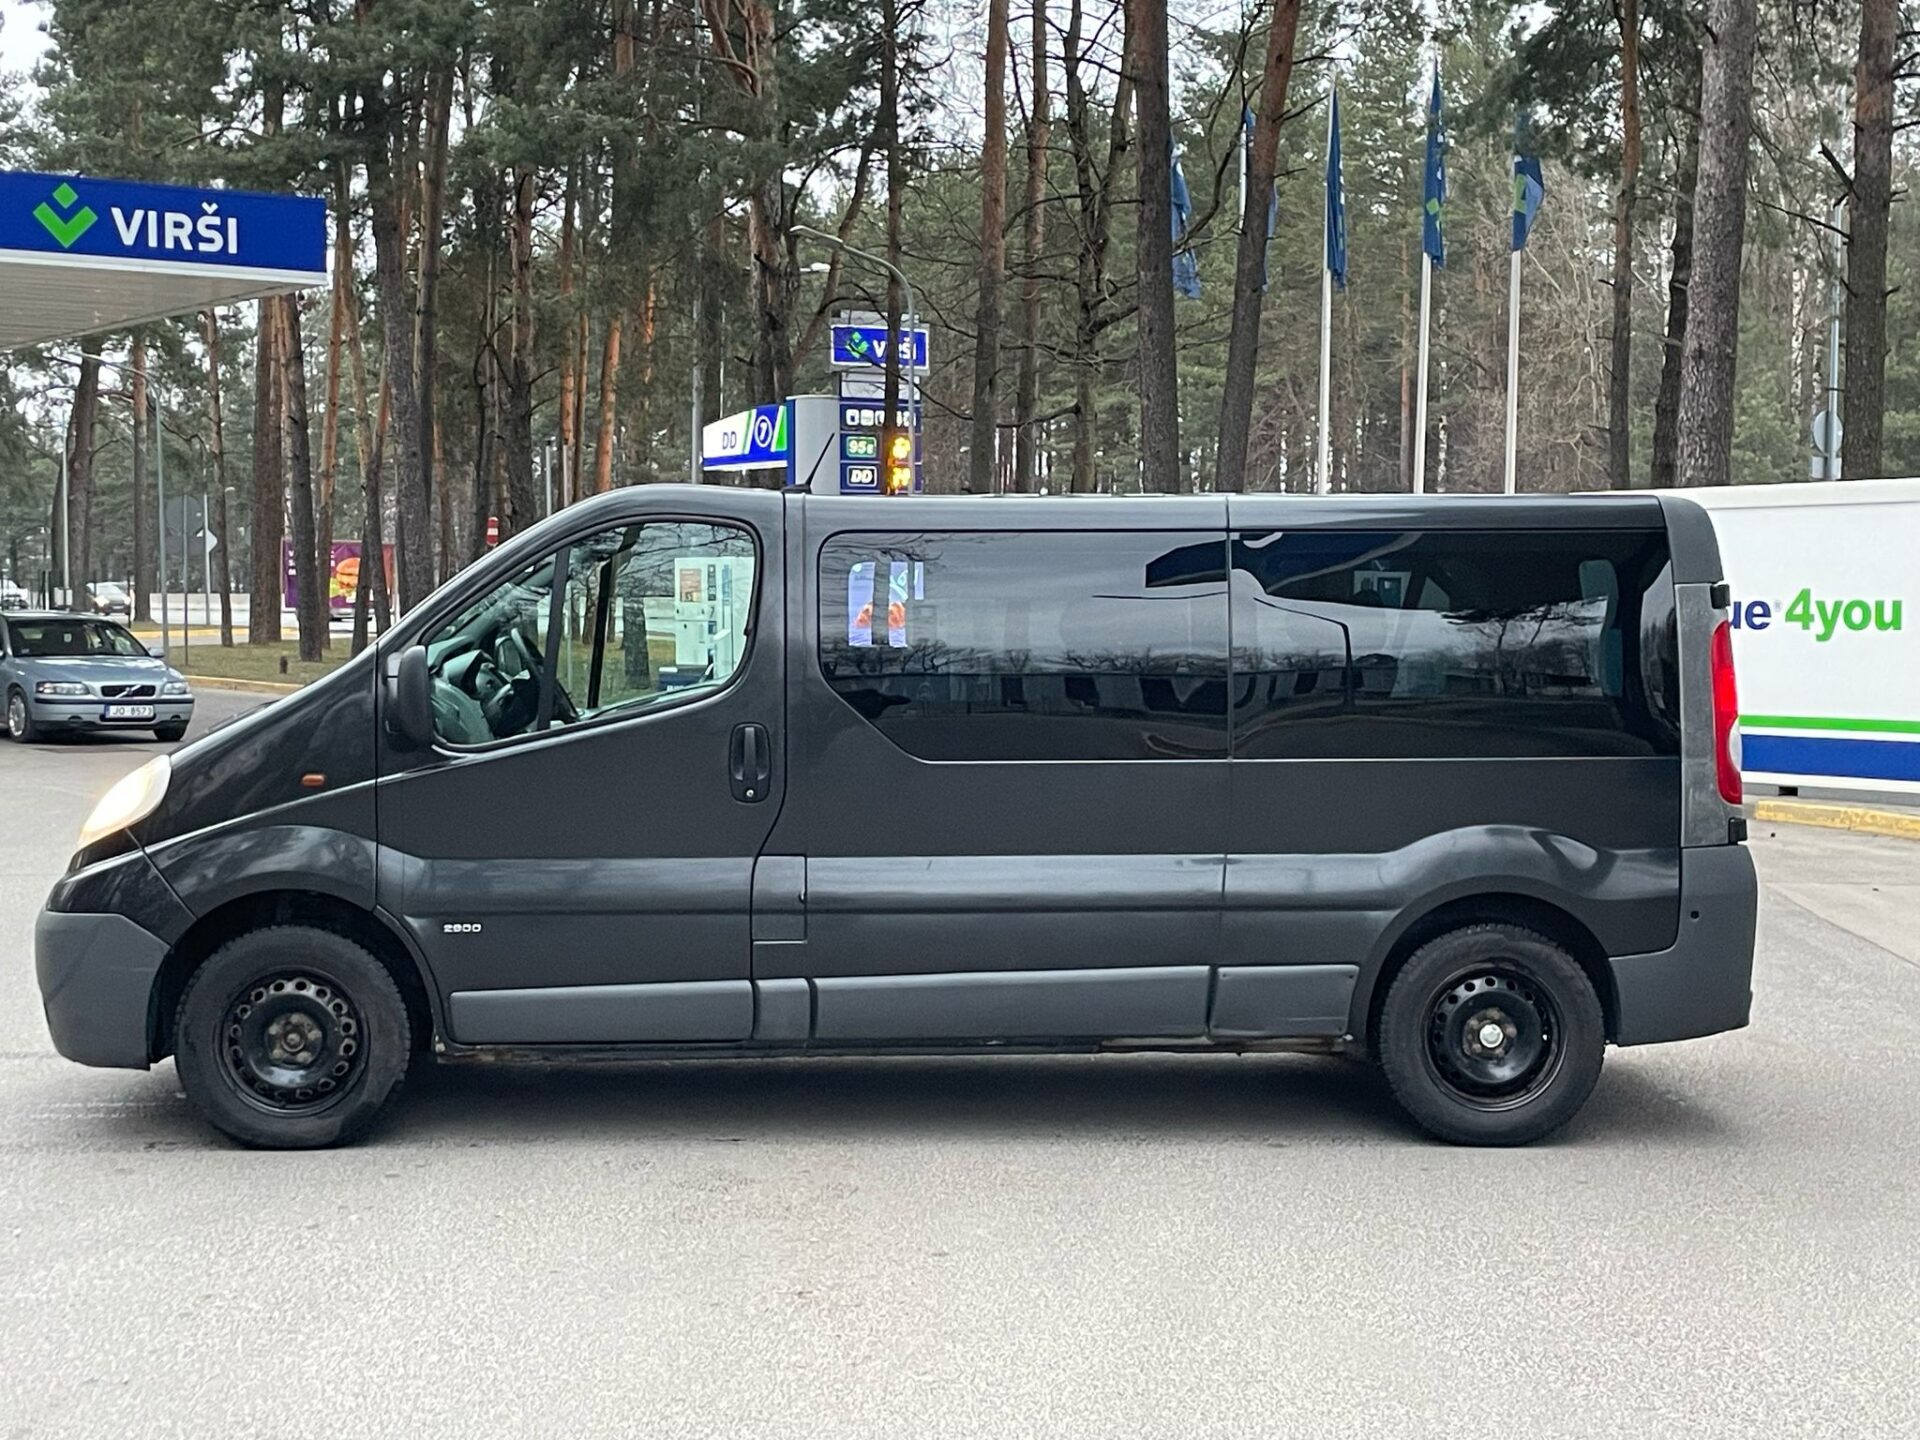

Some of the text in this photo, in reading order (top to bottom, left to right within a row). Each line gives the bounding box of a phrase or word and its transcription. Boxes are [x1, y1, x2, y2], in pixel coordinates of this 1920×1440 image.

[111, 201, 238, 254] VIRŠI
[872, 337, 917, 360] VŠI
[722, 431, 737, 450] DD
[851, 469, 873, 483] DD
[1785, 588, 1902, 642] 4you
